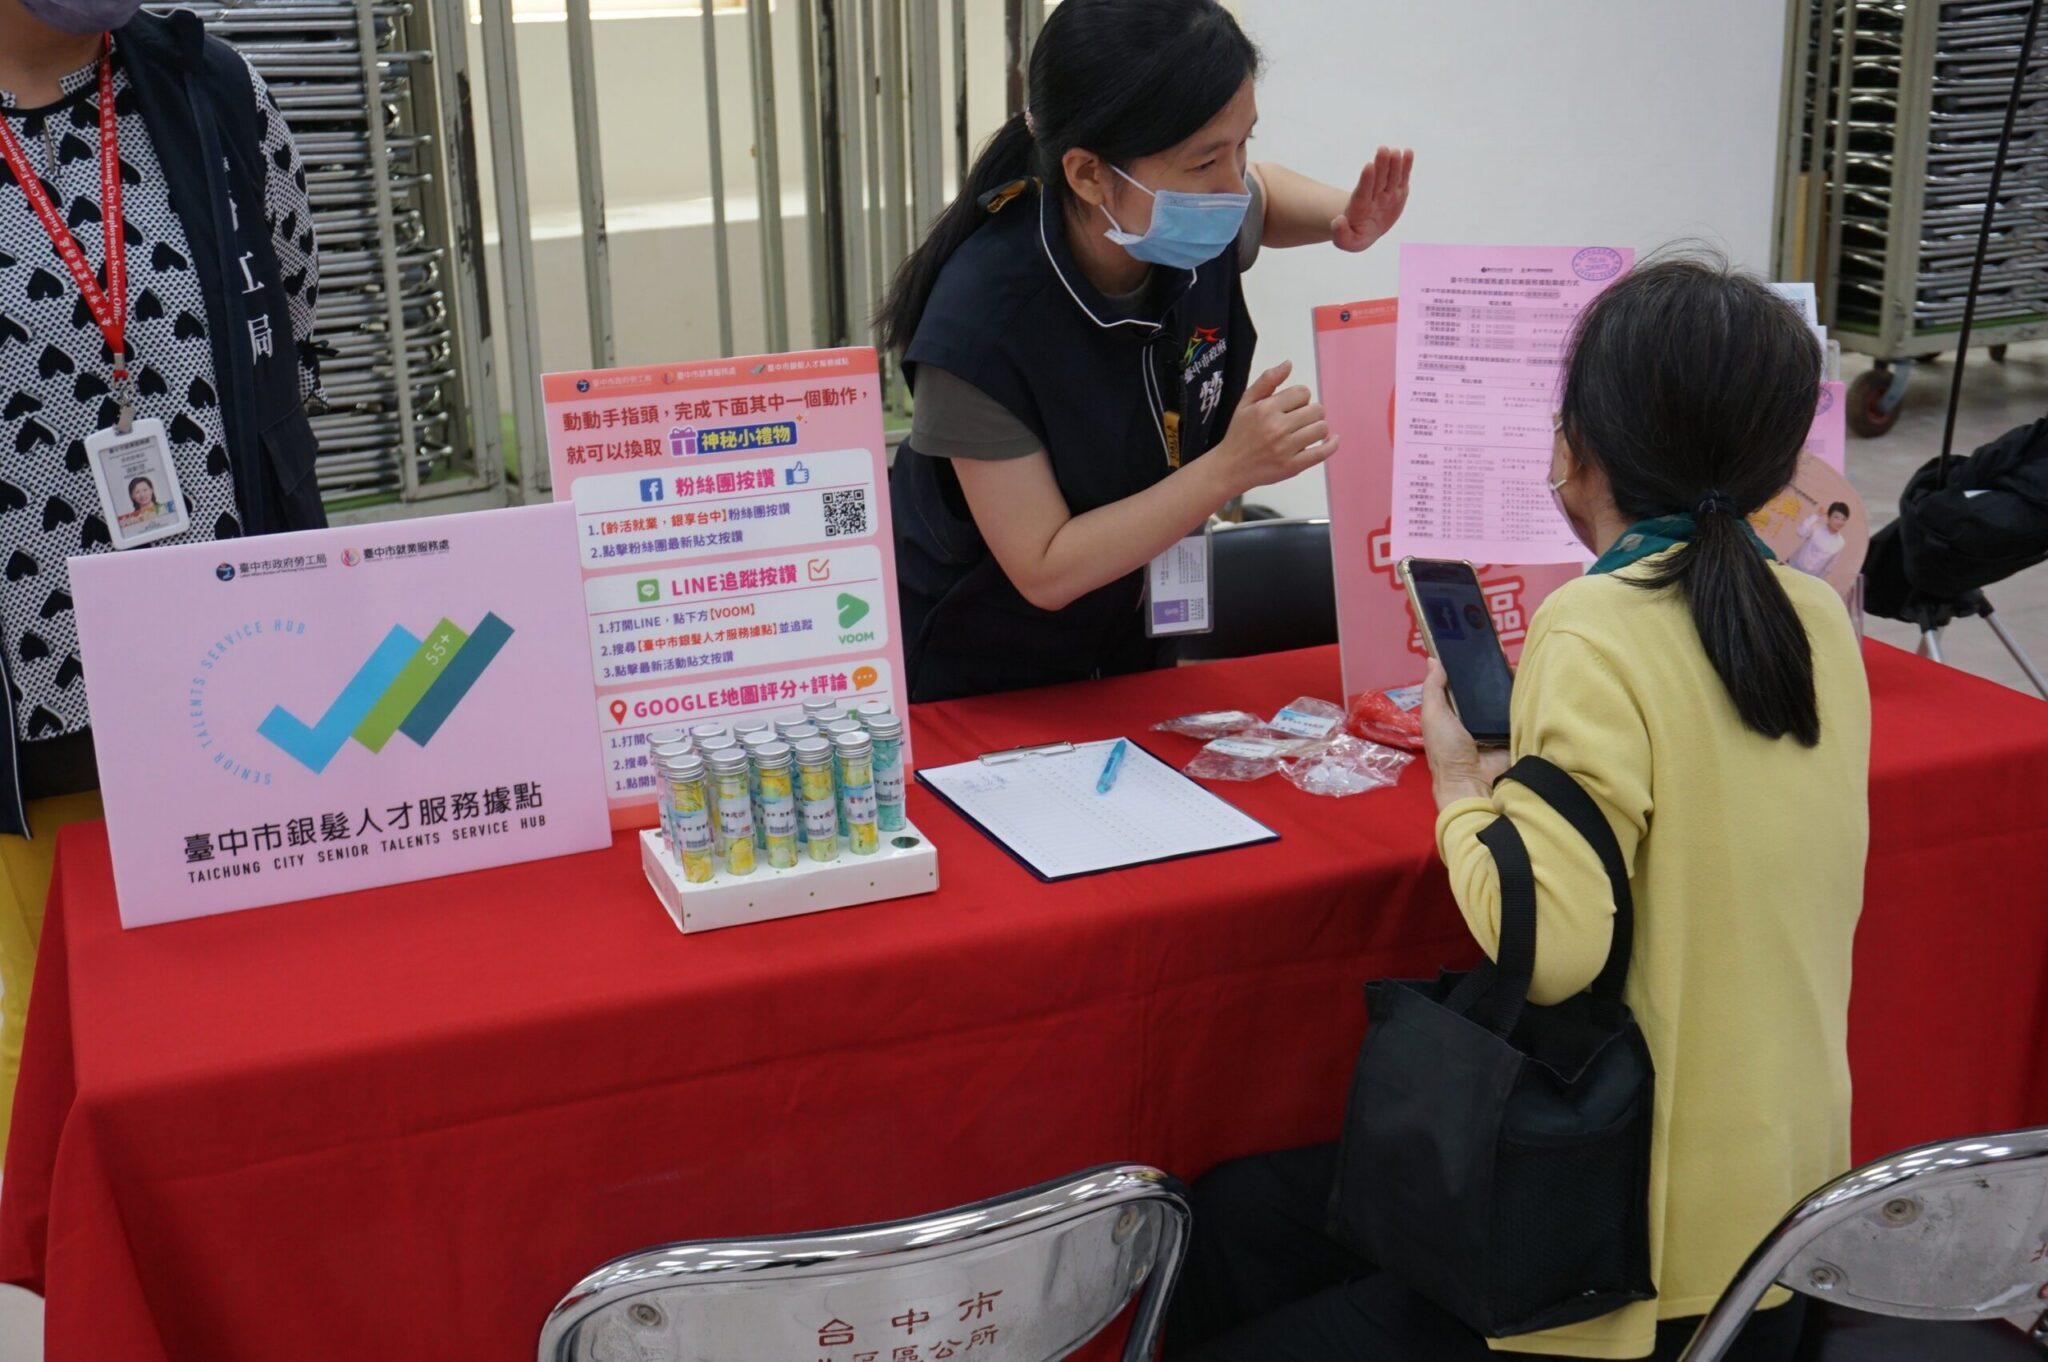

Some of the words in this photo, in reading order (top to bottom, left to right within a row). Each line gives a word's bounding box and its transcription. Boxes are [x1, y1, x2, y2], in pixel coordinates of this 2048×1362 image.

[105, 146, 116, 187] Taichung
[27, 179, 39, 198] City
[107, 186, 118, 207] City
[39, 196, 62, 236] Taichung
[107, 205, 121, 259] Employment
[111, 260, 120, 296] Services
[566, 438, 662, 466] 就可以換取
[701, 424, 792, 451] 神秘小禮物
[675, 468, 776, 498] 粉絲團按讚
[239, 553, 328, 574] 臺中市政府勞工局
[363, 538, 450, 560] 臺中市就業服務處
[671, 564, 798, 597] LINE追蹤按讚
[201, 620, 263, 669] SERVICE
[274, 619, 306, 635] HUB
[838, 630, 875, 646] VOOM
[424, 631, 452, 667] 55+
[189, 676, 213, 749] TALENTS
[633, 672, 849, 719] GOOGLE地圖評分+評論
[213, 752, 272, 785] SENIOR
[183, 780, 544, 865] 臺中市銀髮人才服務據點
[188, 860, 262, 884] TAICHUNG
[273, 853, 306, 871] CITY
[317, 844, 370, 864] SENIOR
[381, 832, 441, 853] TALENTS
[452, 819, 510, 841] SERVICE
[520, 814, 547, 830] HUB
